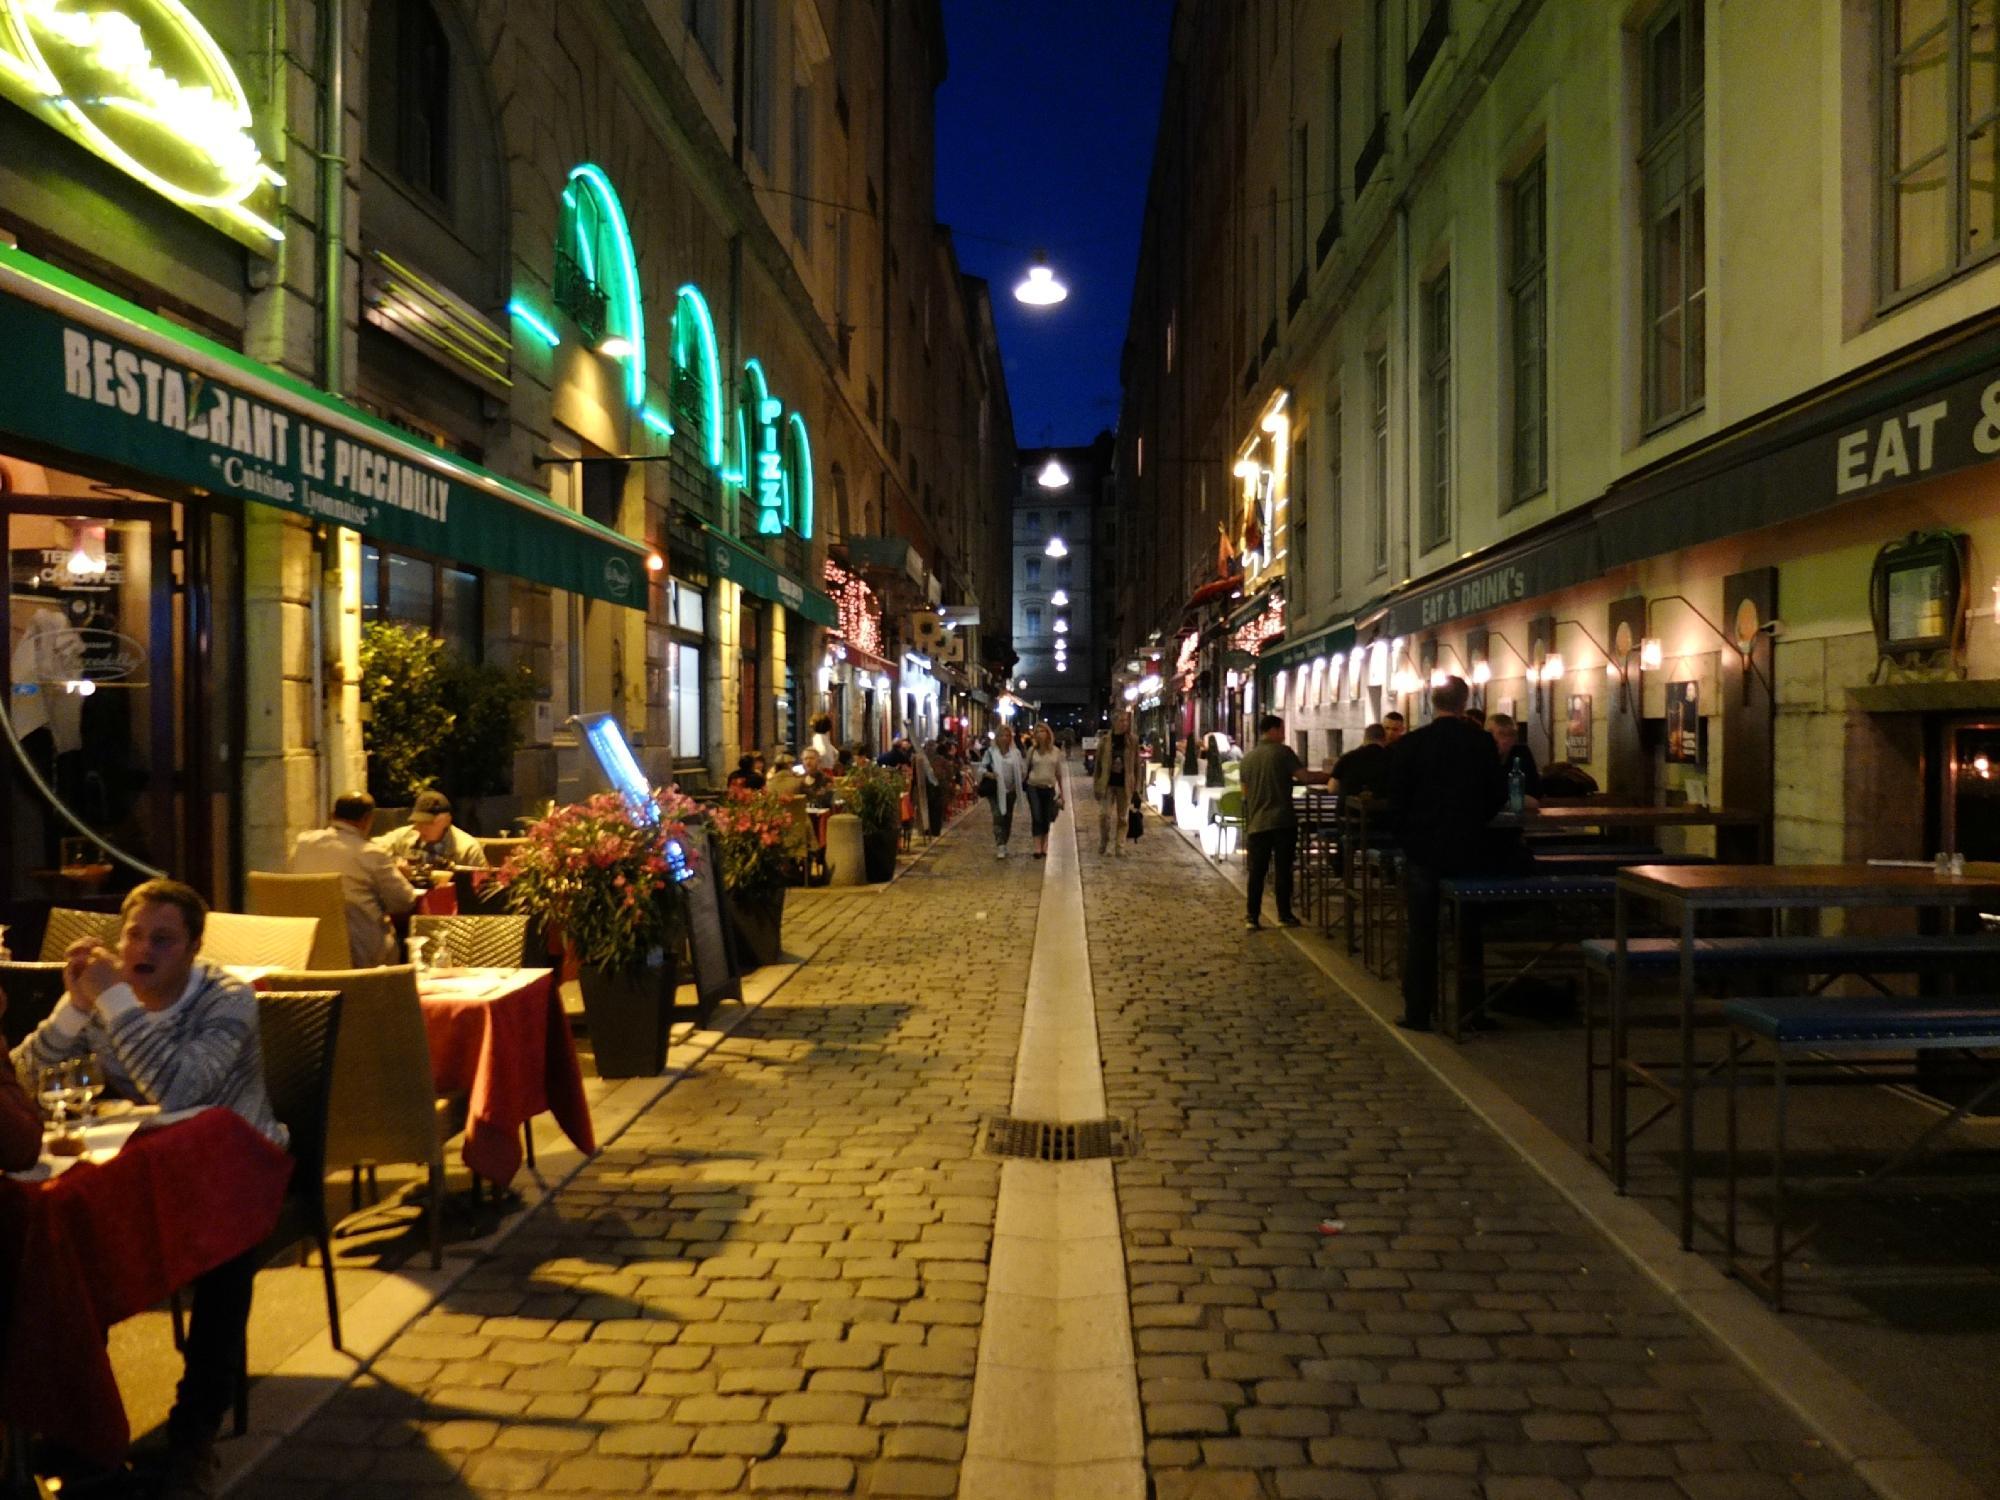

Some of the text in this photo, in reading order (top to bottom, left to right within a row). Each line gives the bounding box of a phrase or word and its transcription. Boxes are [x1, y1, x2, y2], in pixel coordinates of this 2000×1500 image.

[300, 423, 325, 480] LE
[334, 439, 449, 523] PICCADILLY
[759, 399, 782, 534] PIZZA
[1836, 380, 2000, 495] EAT &
[1422, 593, 1444, 626] EAT
[1448, 589, 1458, 618] &
